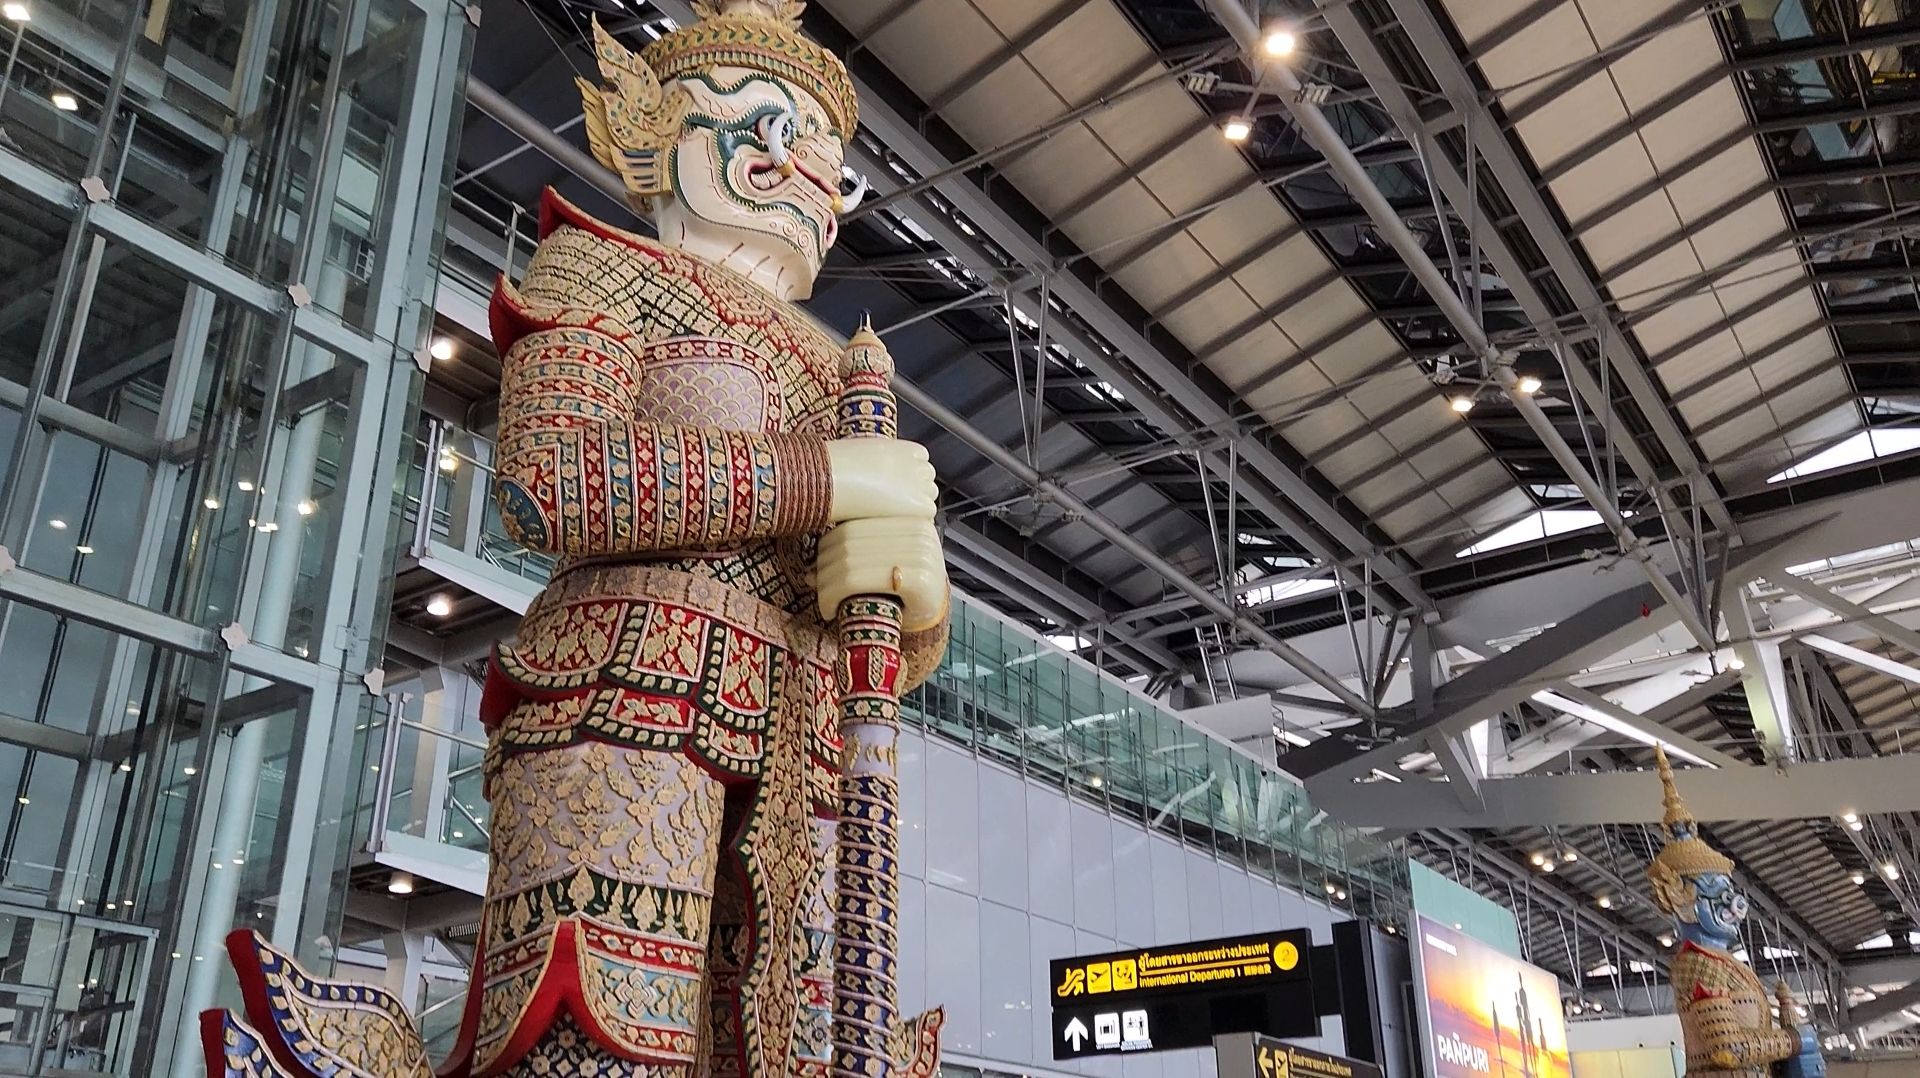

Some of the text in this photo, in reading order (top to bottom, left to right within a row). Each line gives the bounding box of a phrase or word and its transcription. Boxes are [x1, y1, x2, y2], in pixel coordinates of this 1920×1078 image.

[1139, 972, 1189, 988] International
[1190, 967, 1236, 983] Departures
[1437, 1032, 1490, 1073] PAÑPURI
